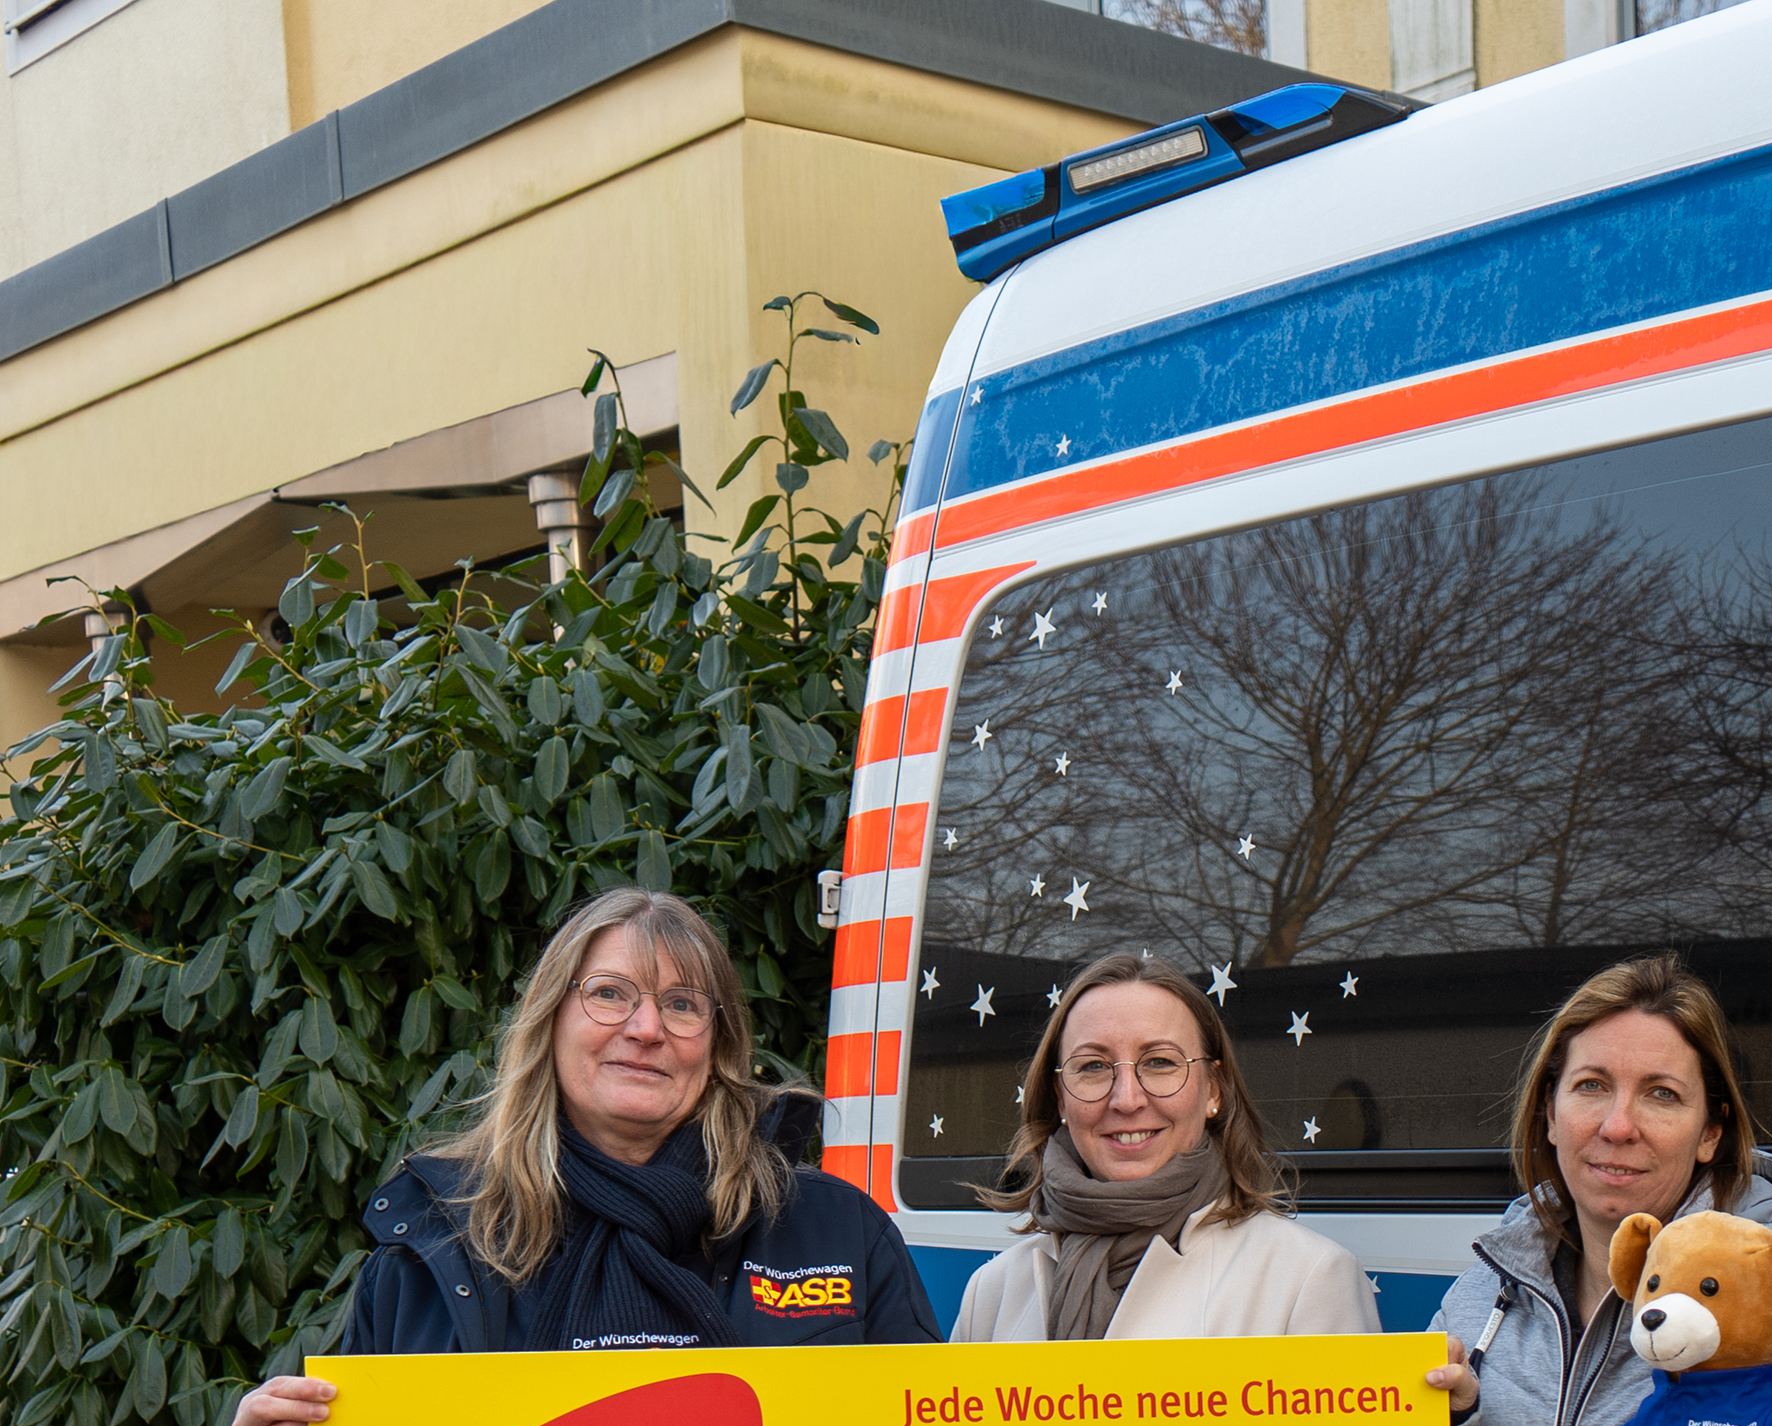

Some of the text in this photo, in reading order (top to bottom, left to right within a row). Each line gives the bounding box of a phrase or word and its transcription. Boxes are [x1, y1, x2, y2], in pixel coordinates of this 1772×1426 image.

[743, 1260, 853, 1280] Der Wünschewagen
[774, 1277, 853, 1309] ASB
[572, 1332, 700, 1350] Der Wünschewagen
[996, 1383, 1123, 1422] Woche
[1137, 1390, 1228, 1419] neue
[1241, 1379, 1414, 1416] Chancen.
